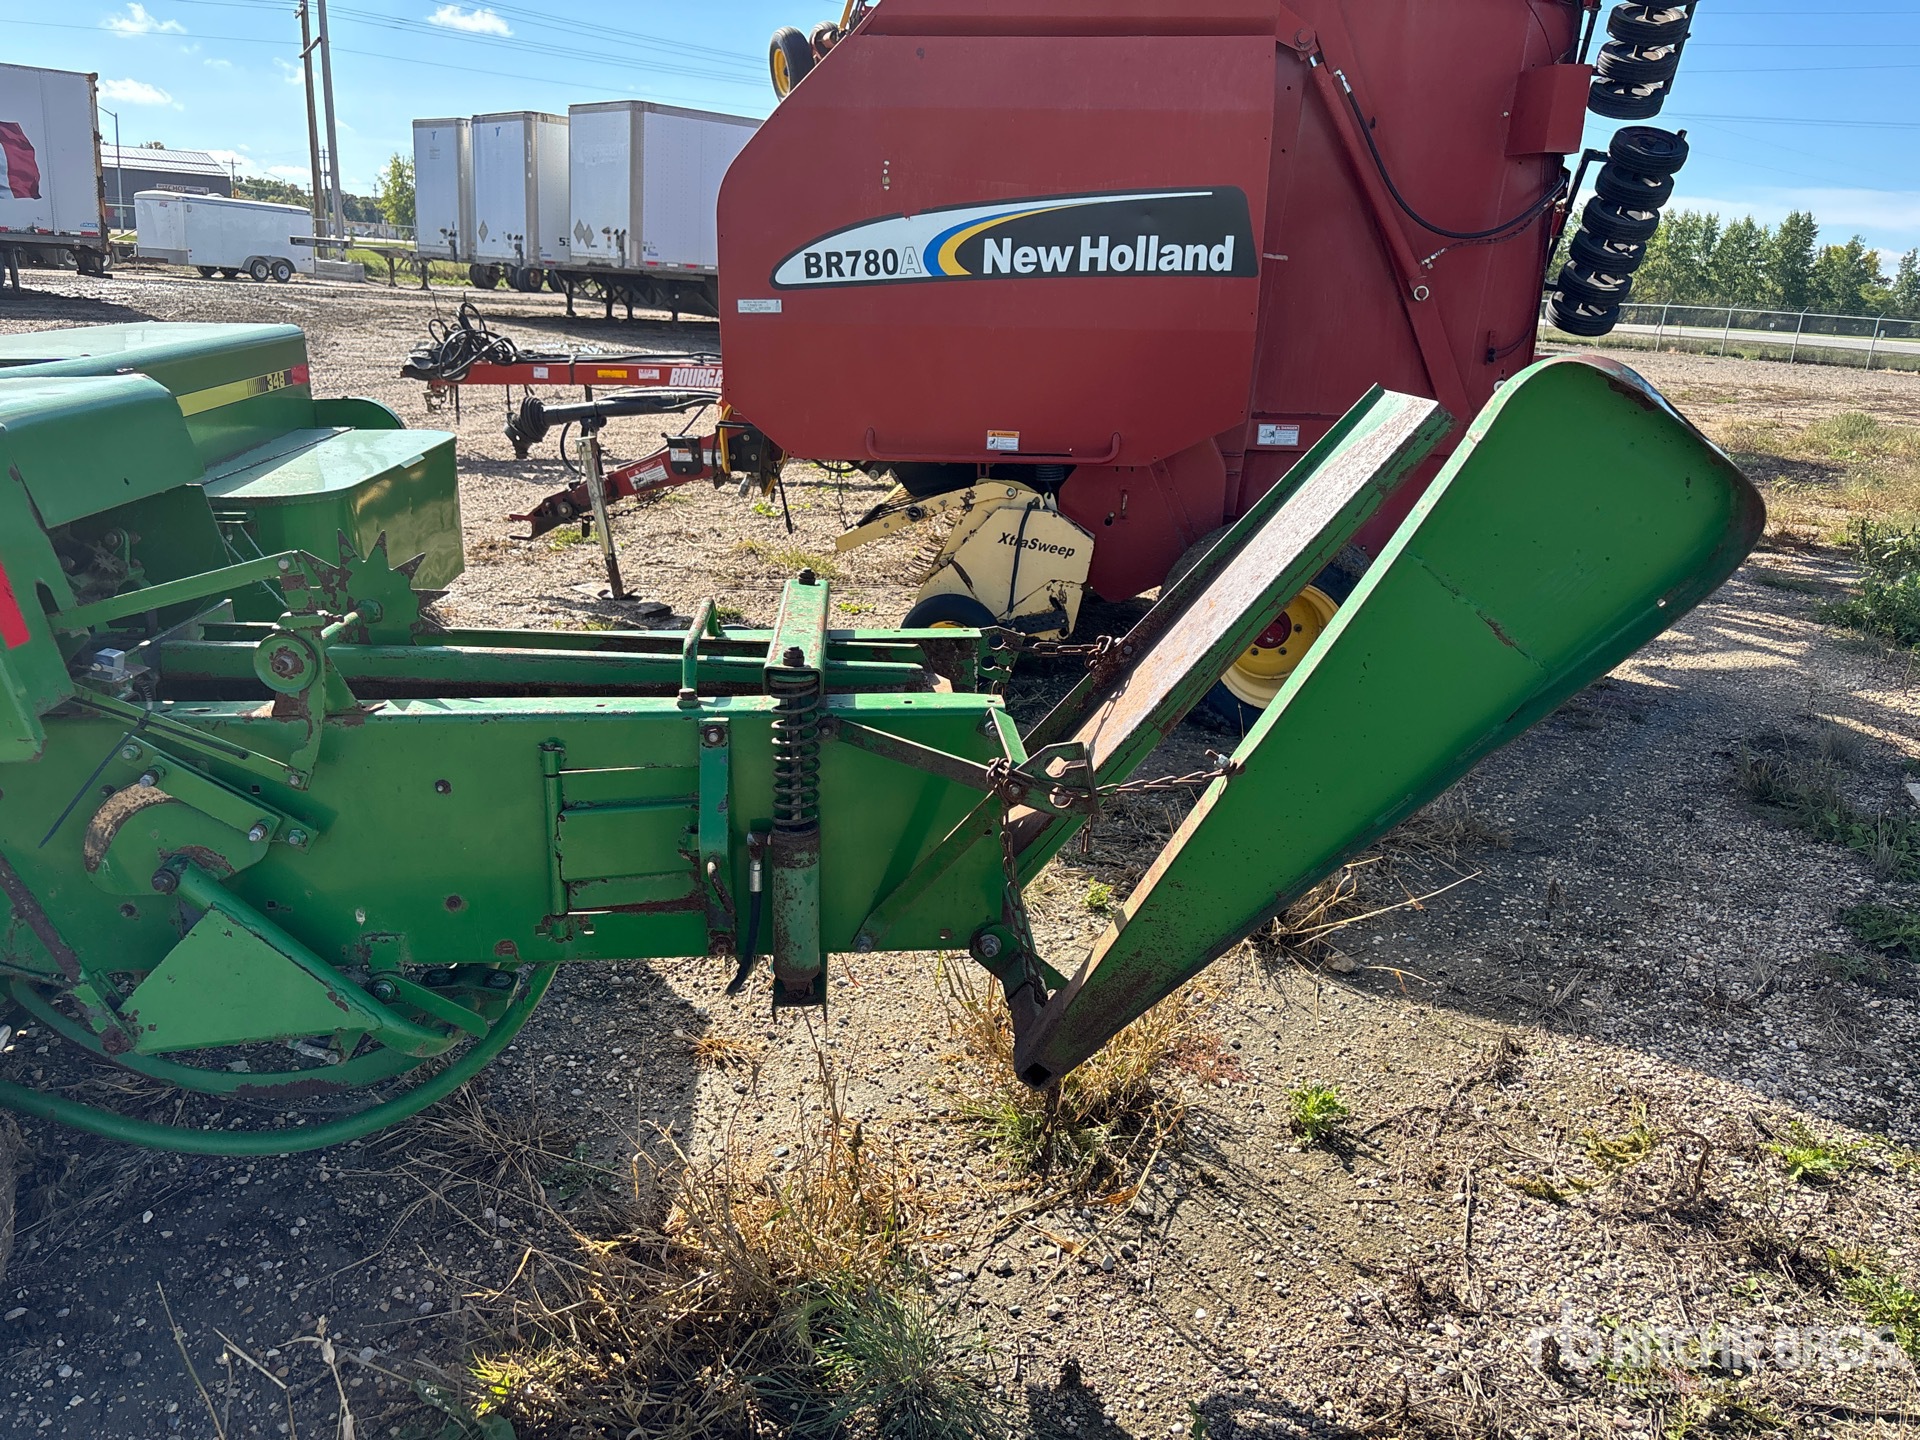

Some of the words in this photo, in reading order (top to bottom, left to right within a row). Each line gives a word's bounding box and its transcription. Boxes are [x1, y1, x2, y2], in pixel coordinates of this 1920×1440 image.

[803, 246, 922, 279] BR780A
[982, 237, 1073, 274] New
[1079, 235, 1235, 272] Holland
[266, 371, 286, 391] 348
